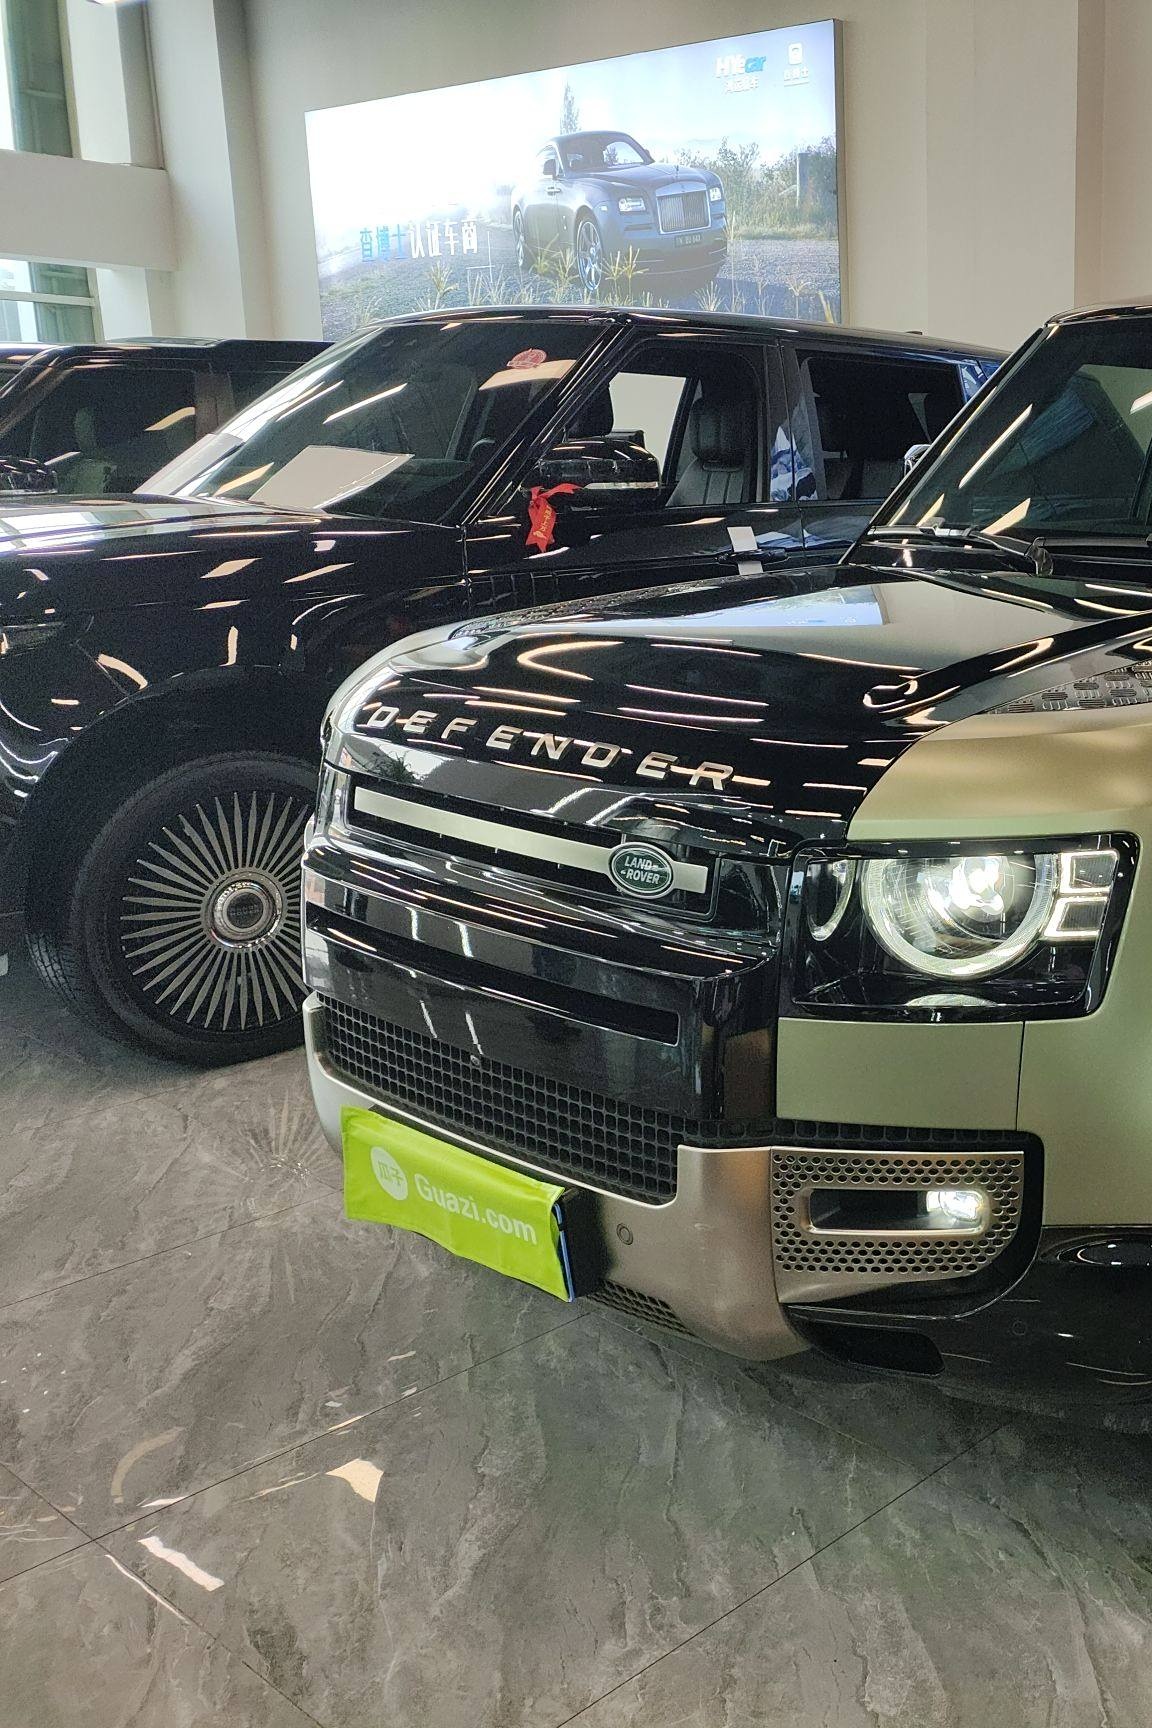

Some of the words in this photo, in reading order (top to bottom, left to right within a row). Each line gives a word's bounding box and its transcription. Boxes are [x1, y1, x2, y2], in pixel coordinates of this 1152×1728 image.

[365, 706, 734, 791] DEFENDER
[624, 856, 653, 871] LAND
[625, 868, 660, 885] ROVER
[414, 1173, 537, 1246] Guazi.com
